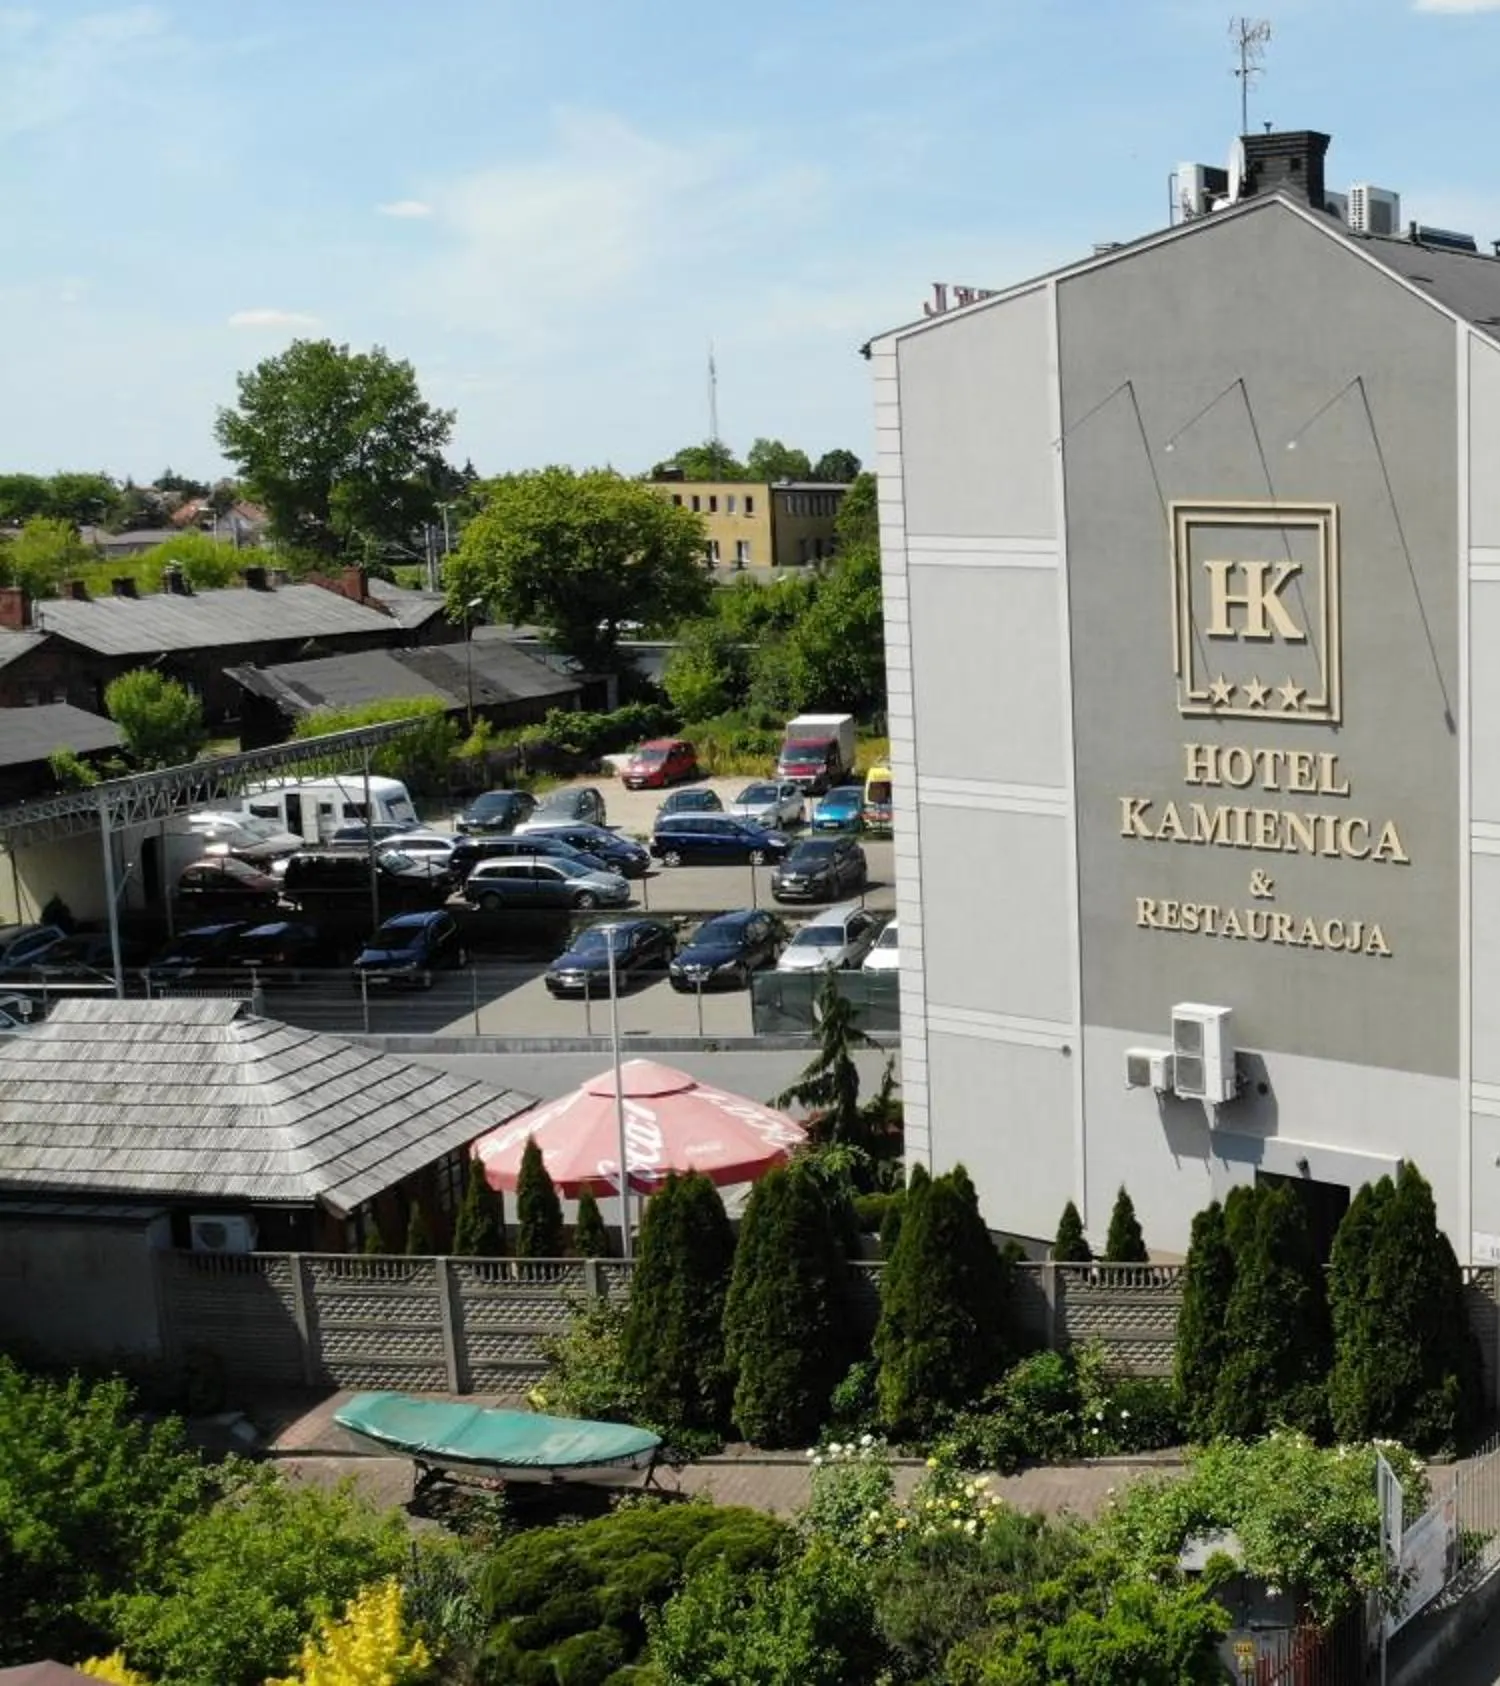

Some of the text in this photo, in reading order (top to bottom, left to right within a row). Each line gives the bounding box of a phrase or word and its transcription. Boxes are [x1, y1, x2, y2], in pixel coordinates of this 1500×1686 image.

[1204, 560, 1306, 640] HK
[1184, 743, 1350, 797] HOTEL
[1120, 797, 1409, 863] KAMIENICA
[1249, 869, 1274, 899] &
[1136, 897, 1393, 956] RESTAURACJA
